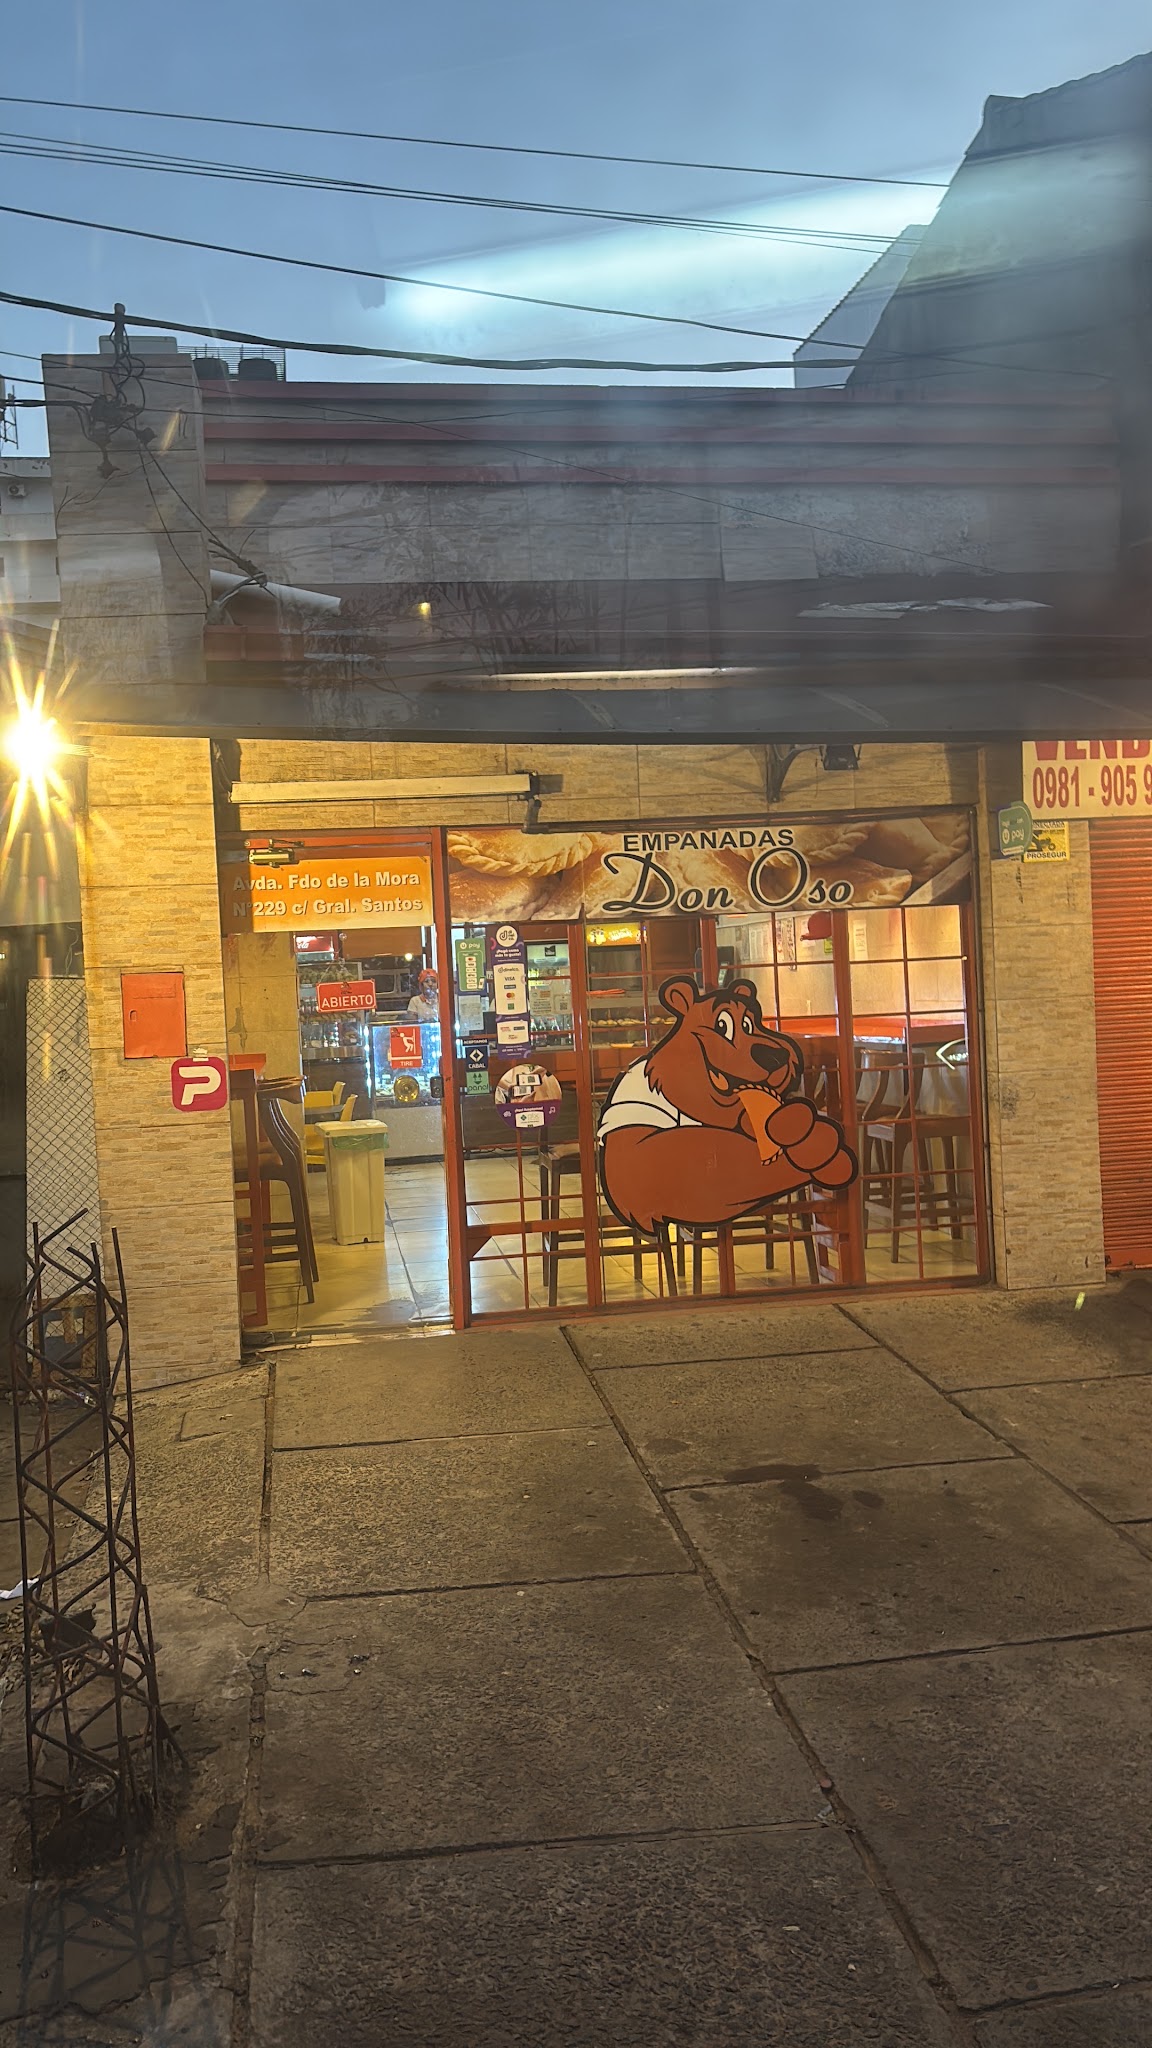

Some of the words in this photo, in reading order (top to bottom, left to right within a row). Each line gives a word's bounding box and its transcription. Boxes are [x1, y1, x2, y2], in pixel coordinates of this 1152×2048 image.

[1033, 766, 1080, 809] 0981
[1101, 765, 1137, 807] 905
[623, 828, 794, 852] EMPANADAS
[233, 874, 283, 891] Avda.
[289, 872, 321, 889] Fdo
[327, 872, 348, 888] de
[354, 872, 371, 888] la
[375, 871, 420, 888] Mora
[602, 852, 734, 912] Don
[749, 846, 854, 907] Oso
[292, 898, 308, 916] c/
[313, 897, 356, 915] Gral.
[361, 896, 423, 913] Santos
[321, 994, 374, 1009] ABIERTO
